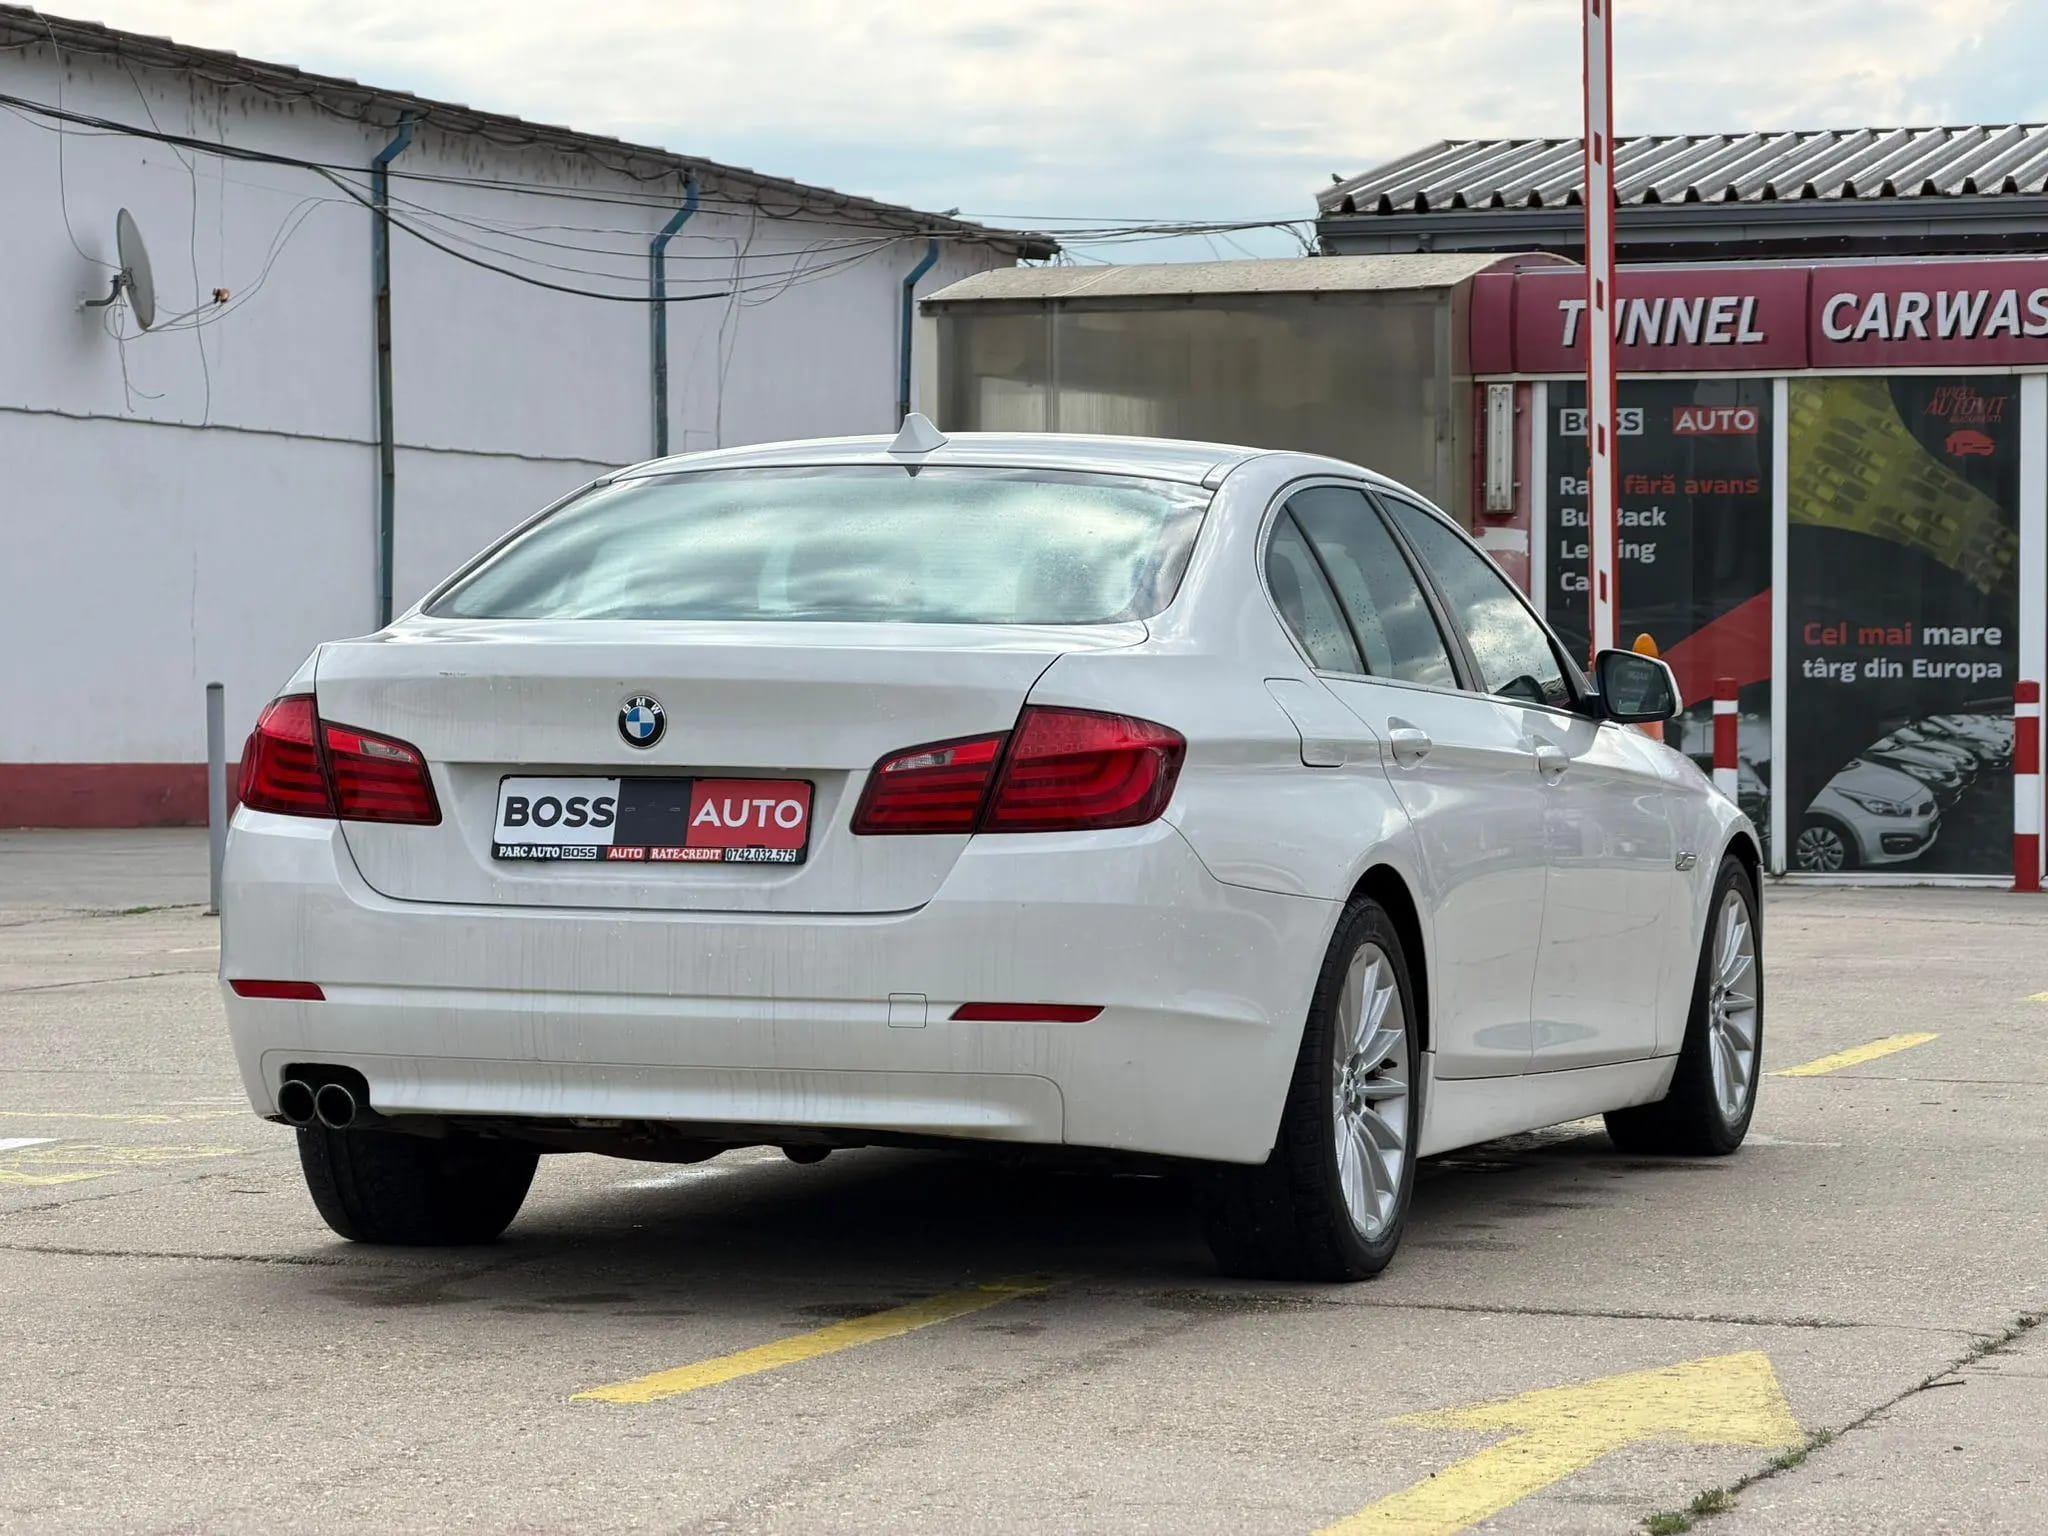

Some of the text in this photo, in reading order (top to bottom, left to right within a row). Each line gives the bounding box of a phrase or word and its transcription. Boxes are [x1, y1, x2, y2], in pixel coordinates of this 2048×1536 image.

[1558, 296, 1765, 346] TNNEL
[1676, 409, 1756, 431] AUTO
[1624, 474, 1676, 495] fără
[1684, 478, 1759, 494] avans
[1561, 506, 1667, 527] Buack
[1561, 539, 1657, 563] Leing
[1803, 622, 2002, 645] Cel mai mare
[1803, 657, 2002, 682] târg din Europa
[622, 698, 660, 714] BMW
[503, 796, 804, 829] BOSS AUTO
[498, 846, 795, 861] PARC AUTO BOSS AUTO RATE-CREDIT 0742.032.575
